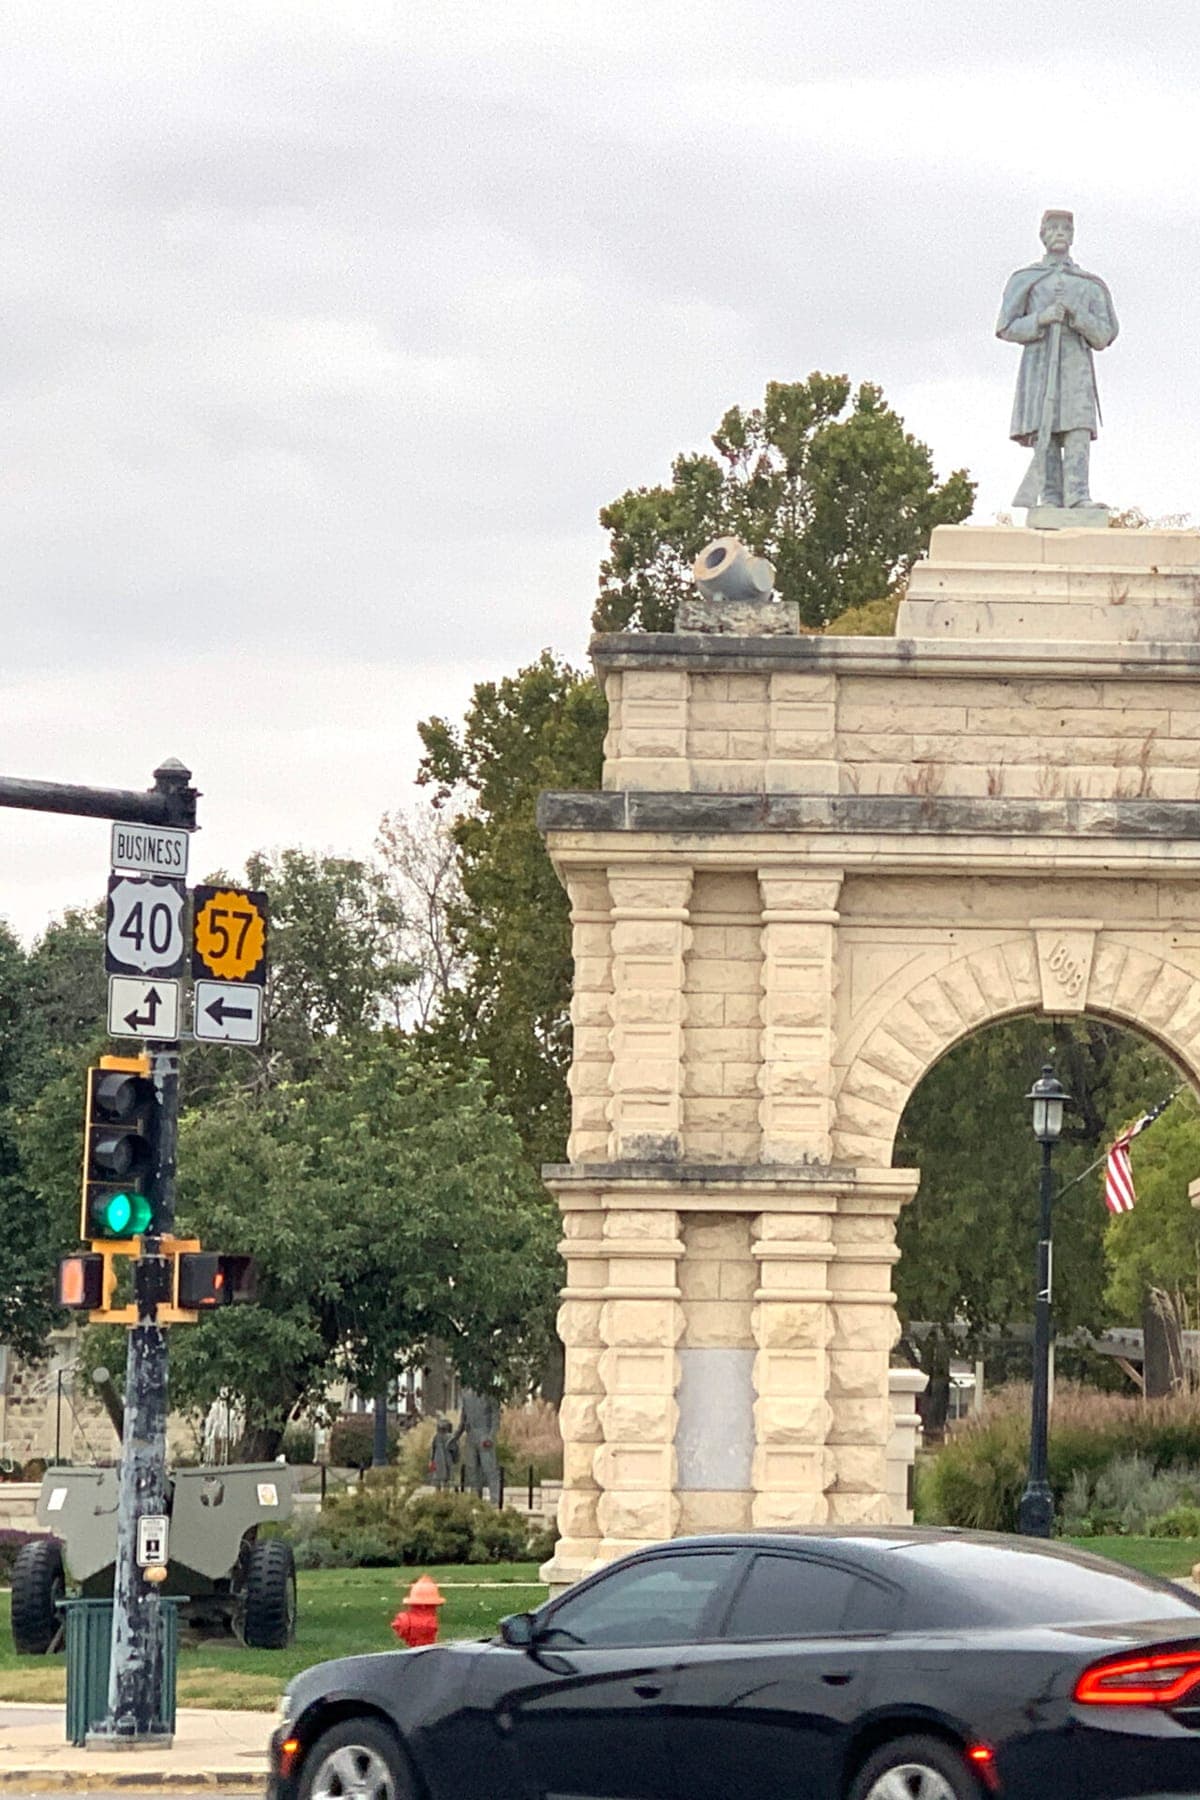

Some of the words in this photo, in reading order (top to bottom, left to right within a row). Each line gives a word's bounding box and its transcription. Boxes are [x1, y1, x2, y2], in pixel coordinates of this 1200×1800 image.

[117, 833, 182, 867] BUSINESS
[119, 901, 173, 955] 40
[208, 908, 253, 961] 57
[1044, 939, 1083, 998] 1898
